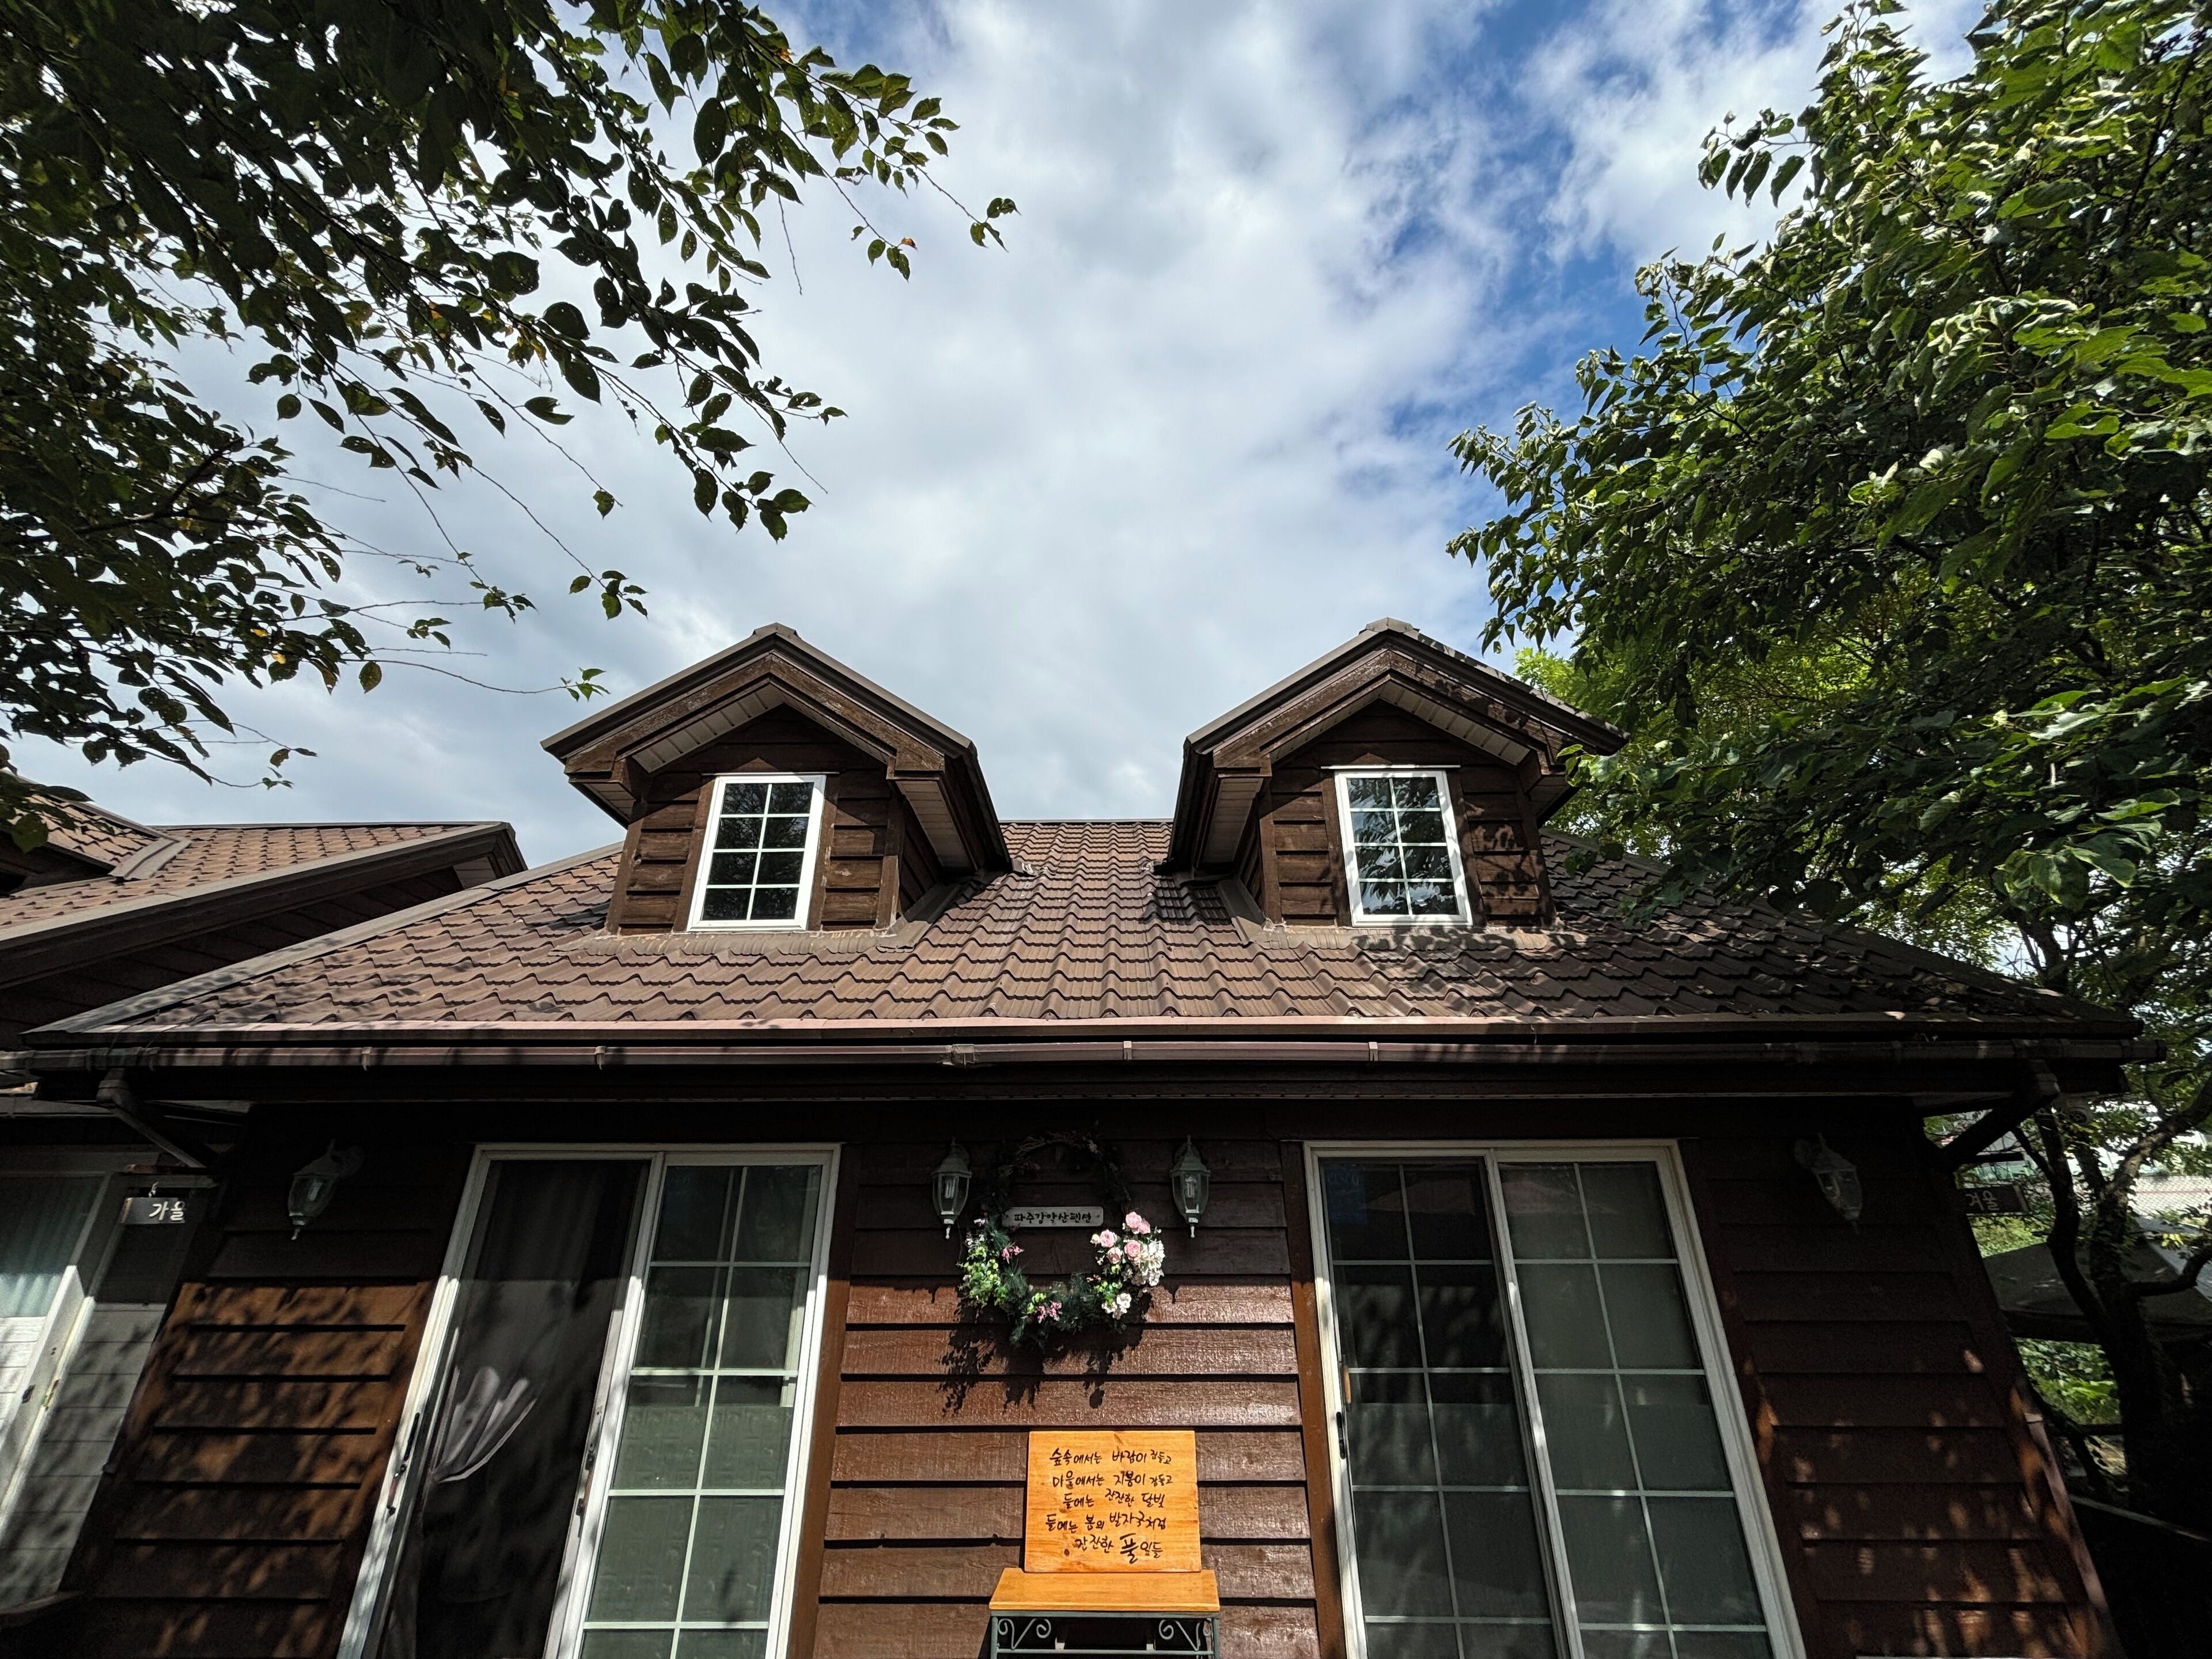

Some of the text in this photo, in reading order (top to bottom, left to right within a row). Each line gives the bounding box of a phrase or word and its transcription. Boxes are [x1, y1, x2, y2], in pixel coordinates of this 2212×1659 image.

[149, 1200, 186, 1221] 가을
[1965, 1190, 2000, 1211] 겨울
[1049, 1447, 1102, 1466] 숲속에서는
[1112, 1450, 1147, 1463] 바람이
[1052, 1470, 1105, 1488] 마을에서는
[1113, 1470, 1145, 1487] 지붕이
[1063, 1488, 1165, 1509] 들에는 잔잔한 달빛
[1046, 1510, 1166, 1533] 들에는 봄의 발자국처럼
[1074, 1533, 1163, 1564] 잔잔한 풀잎들
